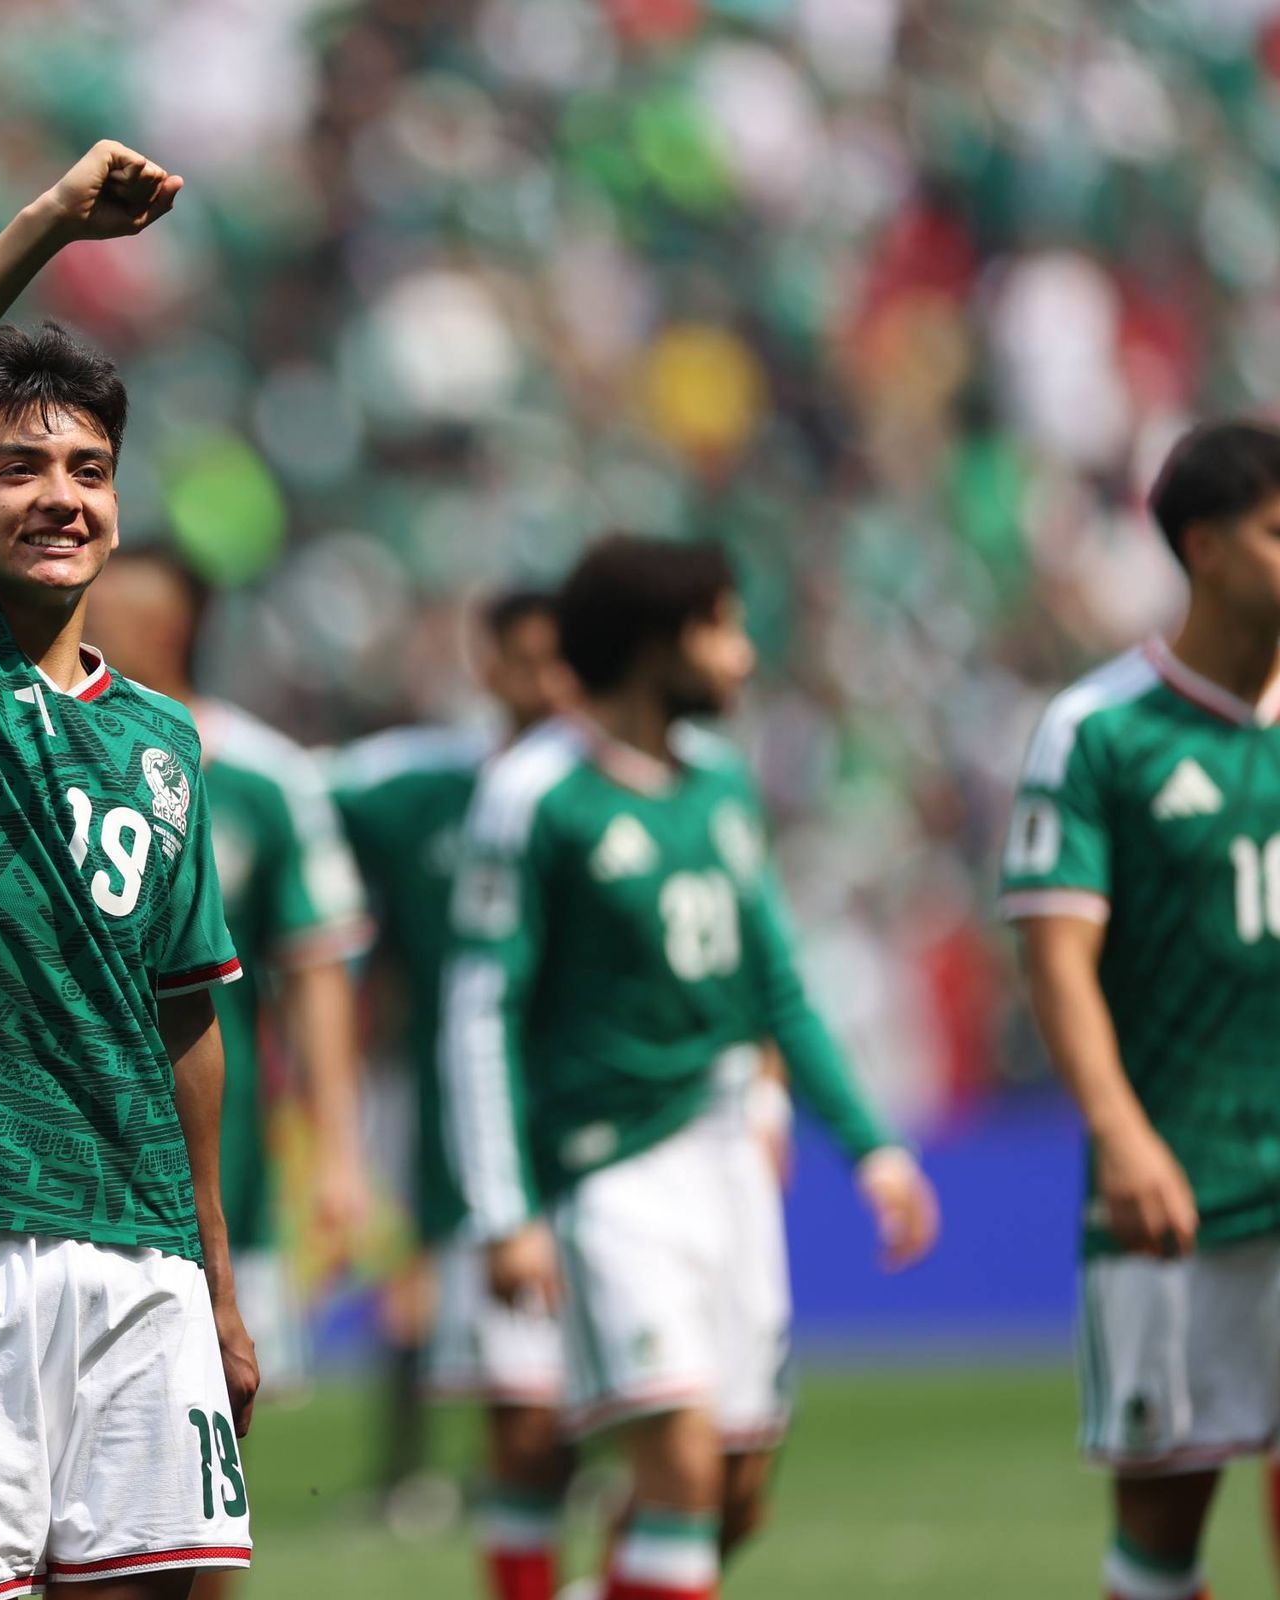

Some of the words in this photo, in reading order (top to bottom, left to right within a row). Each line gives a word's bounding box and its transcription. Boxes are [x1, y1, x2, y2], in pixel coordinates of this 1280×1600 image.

[67, 787, 151, 916] 19
[154, 803, 185, 832] MÉXICO
[188, 1408, 247, 1519] 19
